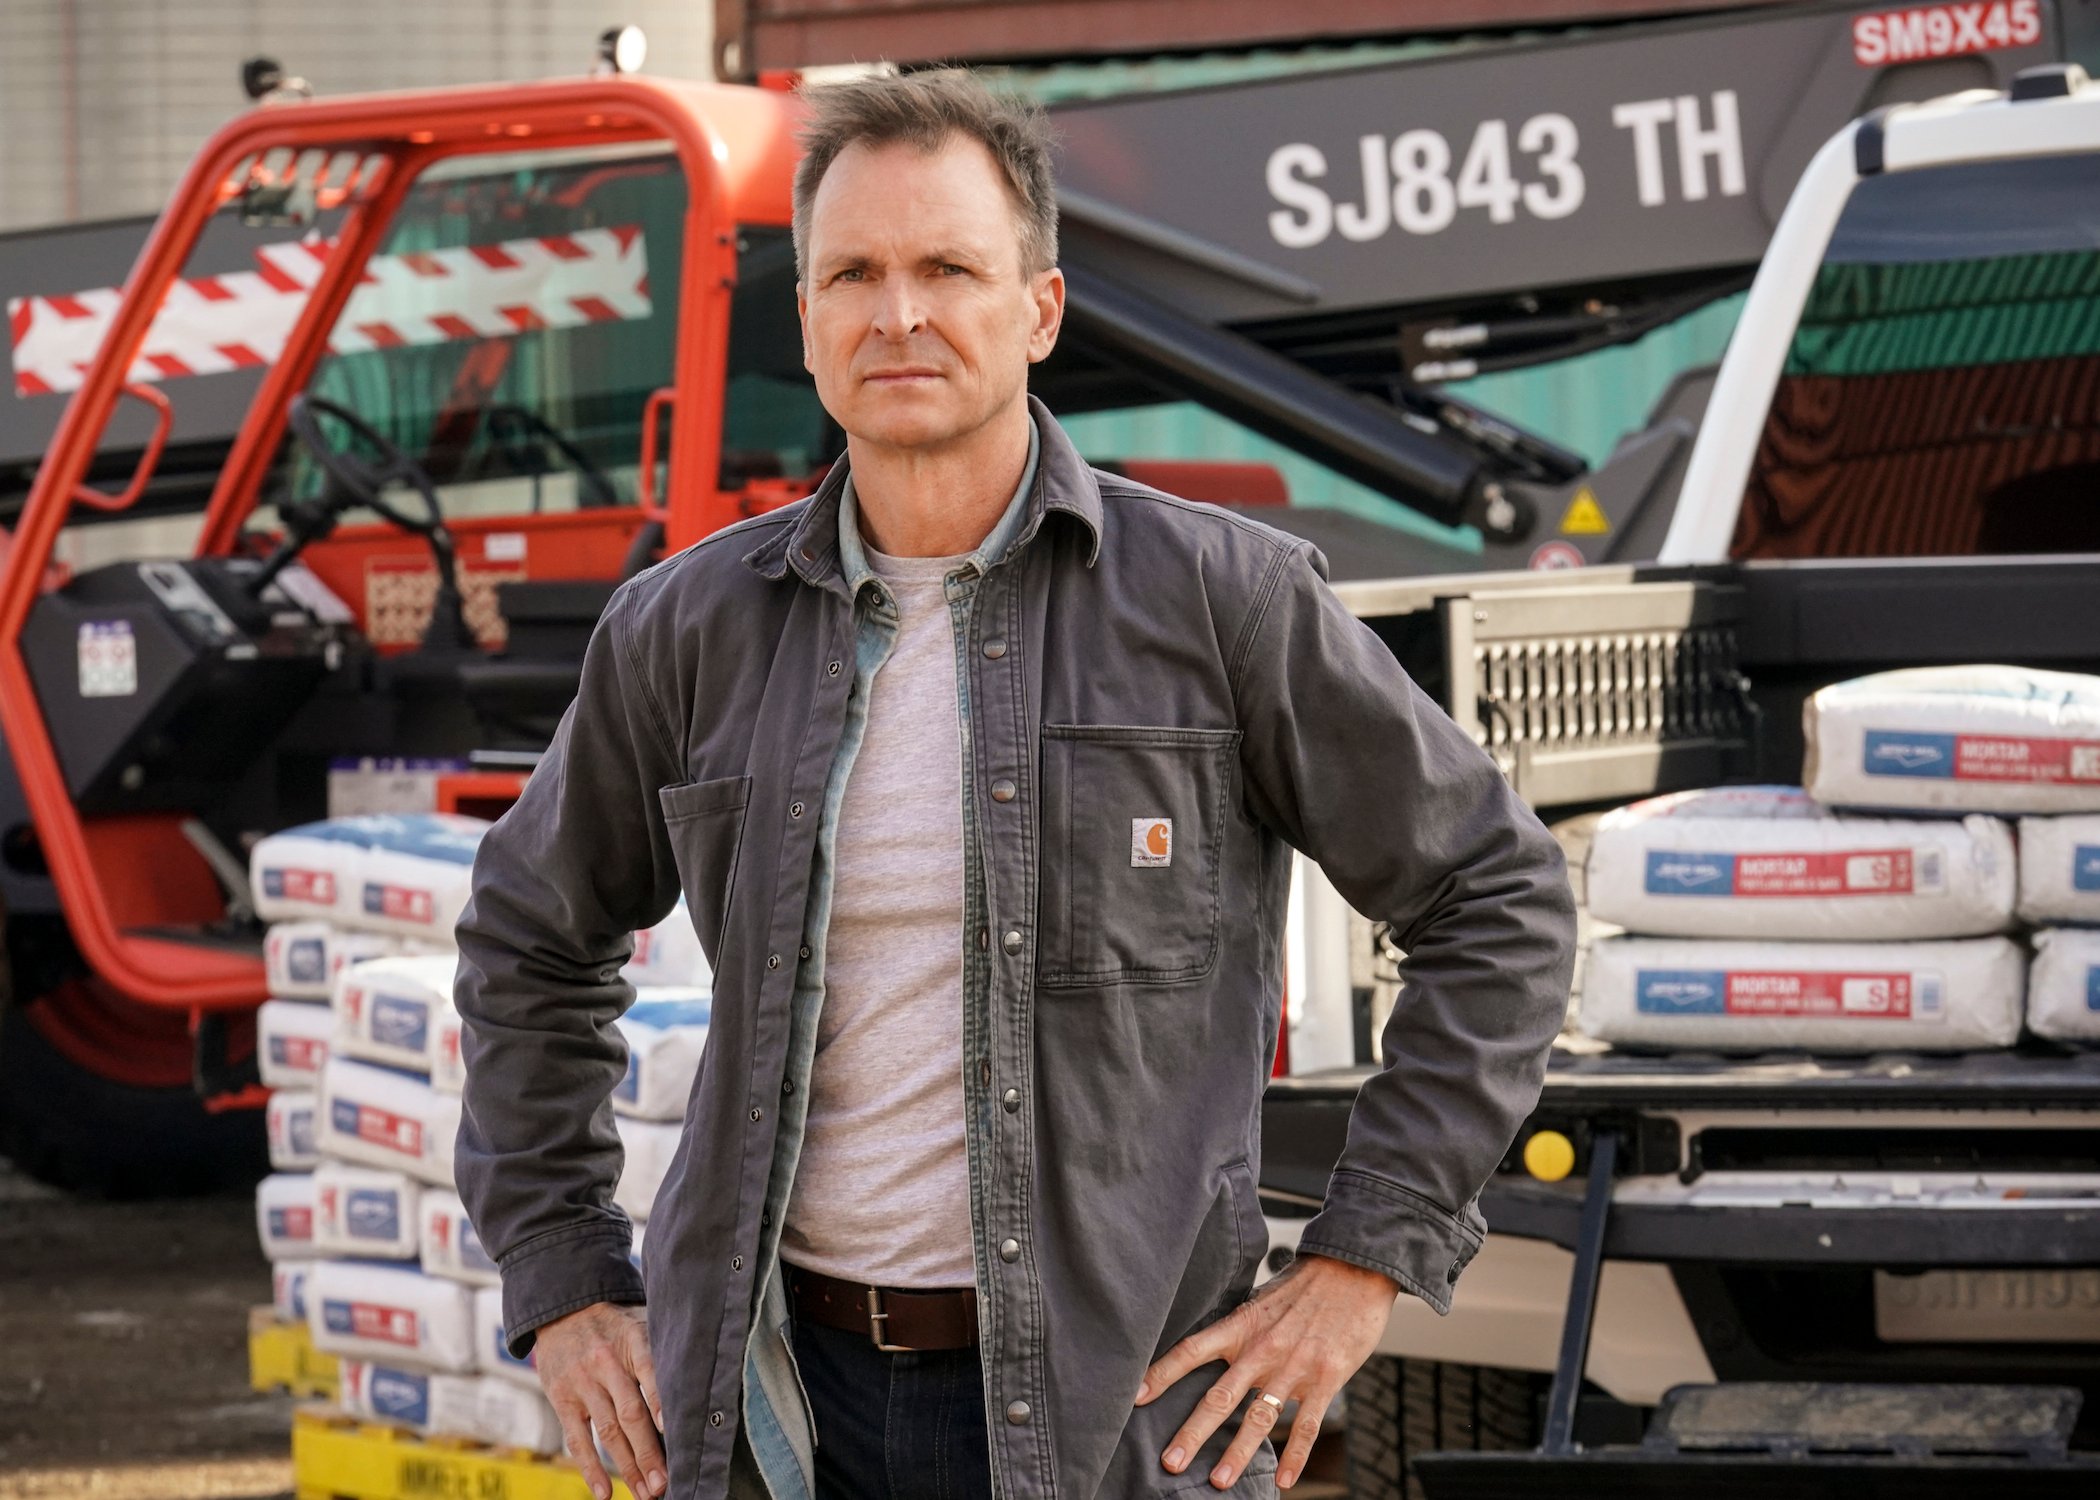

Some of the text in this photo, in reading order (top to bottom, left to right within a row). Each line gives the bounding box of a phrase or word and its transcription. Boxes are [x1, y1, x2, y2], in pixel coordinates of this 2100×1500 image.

[1854, 0, 2041, 64] SM9X45
[1265, 90, 1747, 249] SJ843 TH
[1960, 741, 2029, 761] MORTAR
[1740, 857, 1807, 876] MORTAR
[1731, 976, 1800, 995] MORTAR
[1868, 982, 1888, 1007] S
